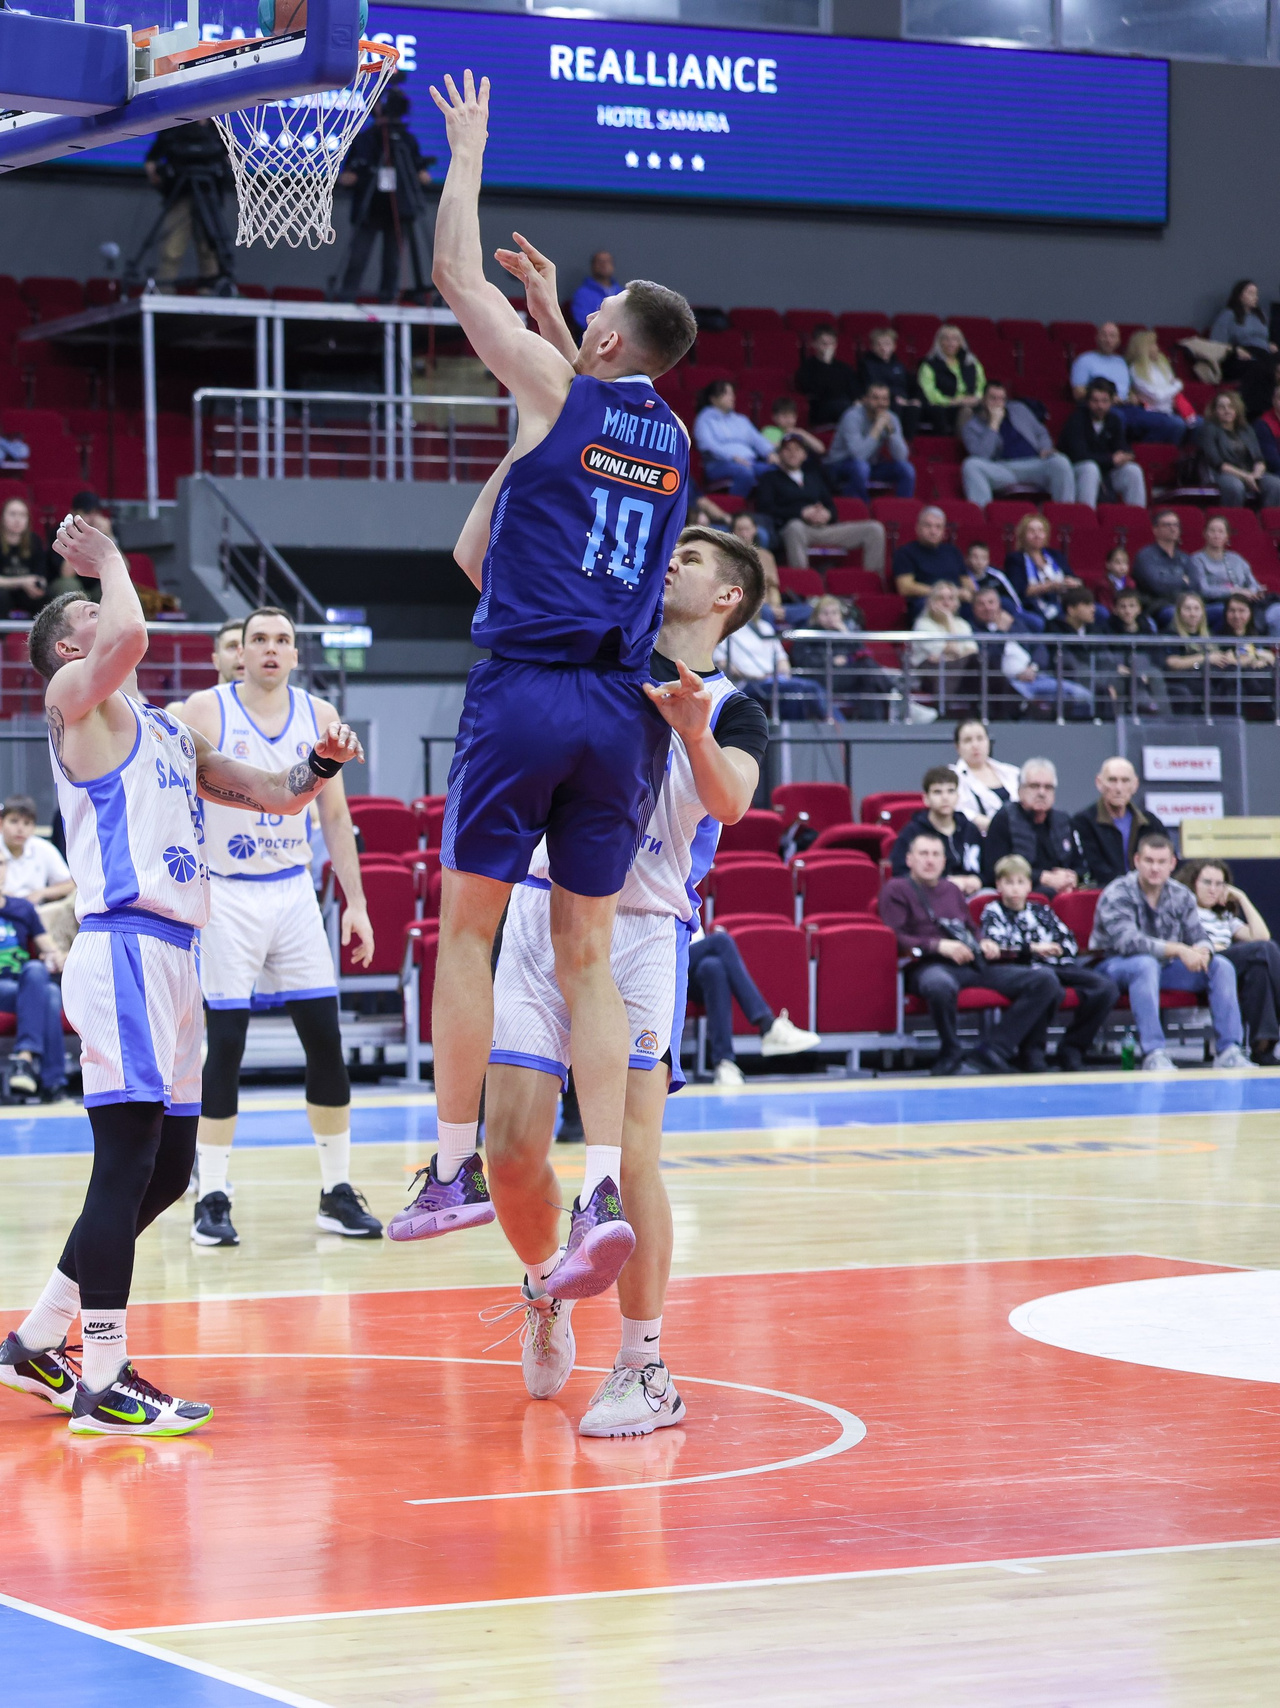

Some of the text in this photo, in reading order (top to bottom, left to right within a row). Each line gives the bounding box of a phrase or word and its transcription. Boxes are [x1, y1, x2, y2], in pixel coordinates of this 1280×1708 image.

[549, 43, 778, 95] REALLIANCE
[596, 104, 730, 133] HOTEL SAMARA
[589, 451, 661, 485] WINLINE
[581, 487, 654, 587] 10
